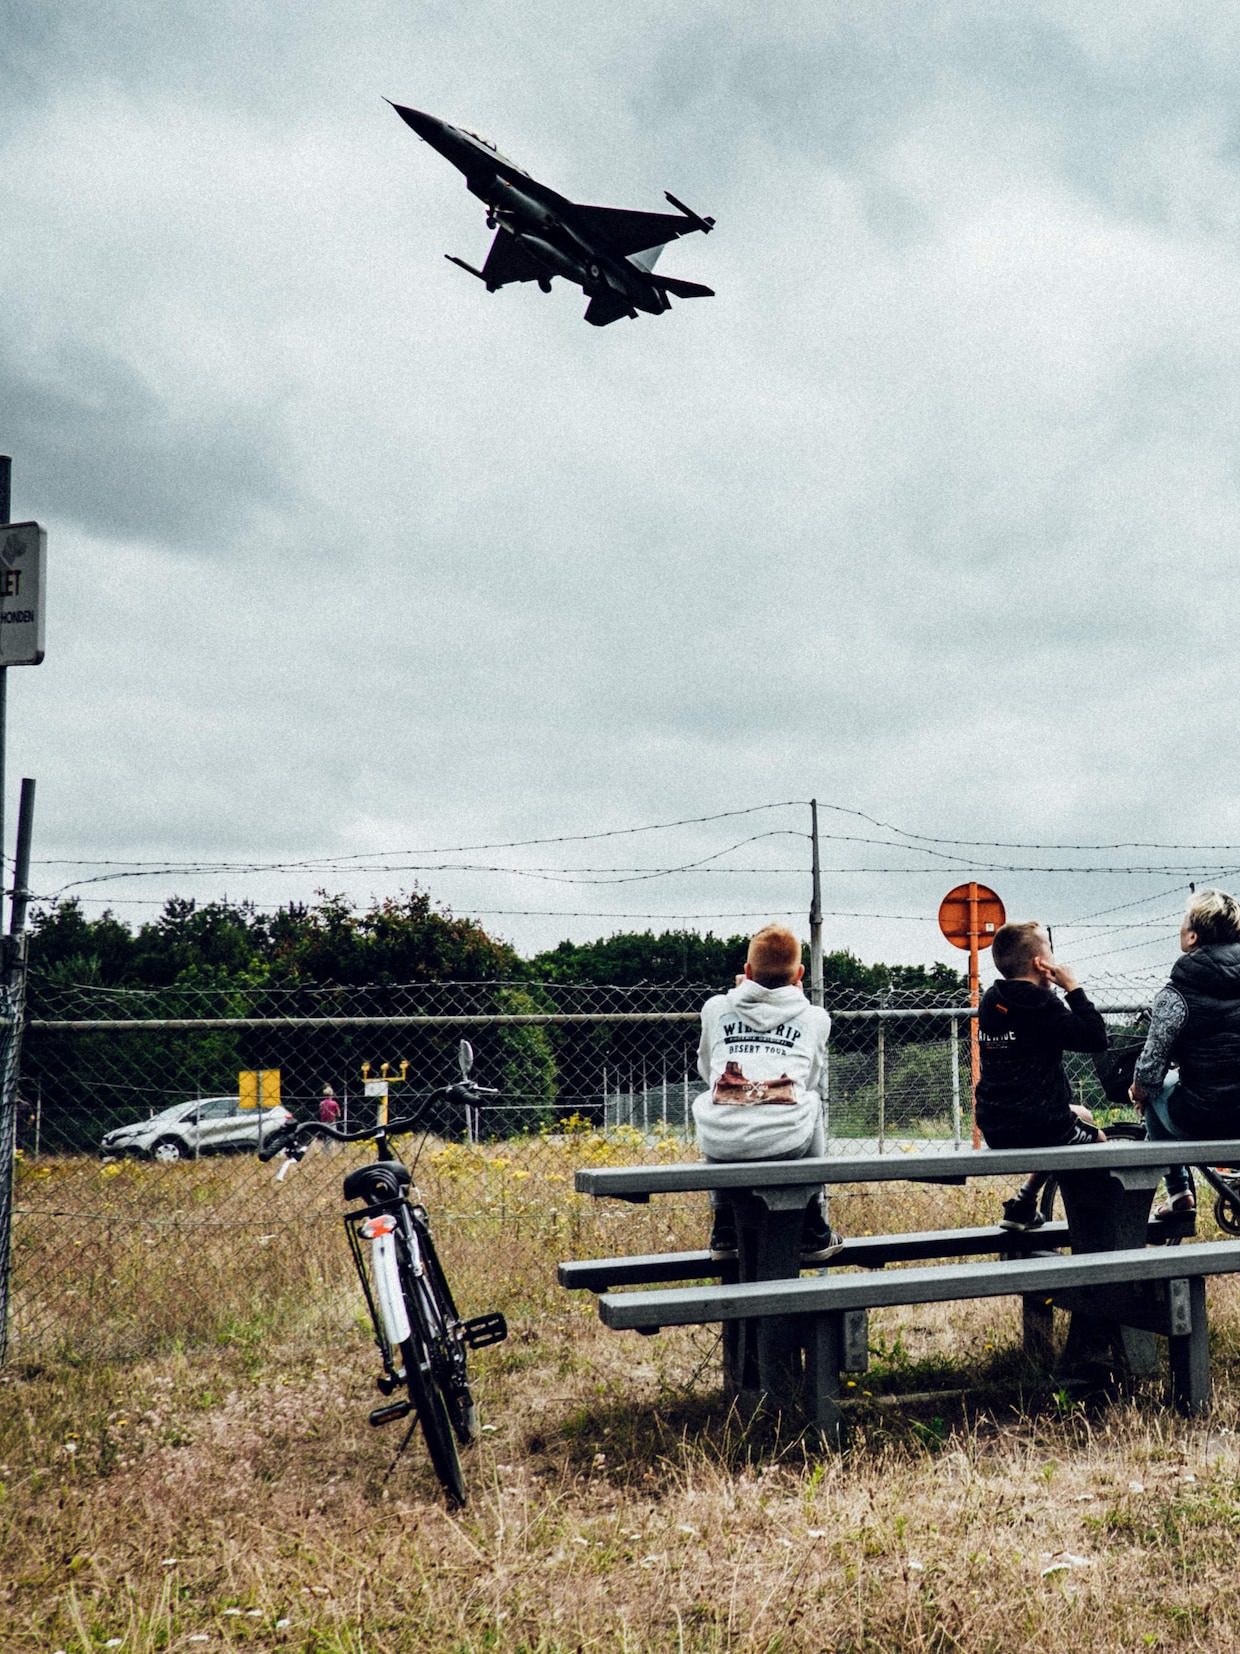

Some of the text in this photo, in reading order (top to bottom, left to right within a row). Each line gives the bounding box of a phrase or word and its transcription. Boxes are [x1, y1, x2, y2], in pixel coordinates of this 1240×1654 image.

[0, 610, 35, 624] HONDEN
[729, 1044, 787, 1056] DESERT TOUR
